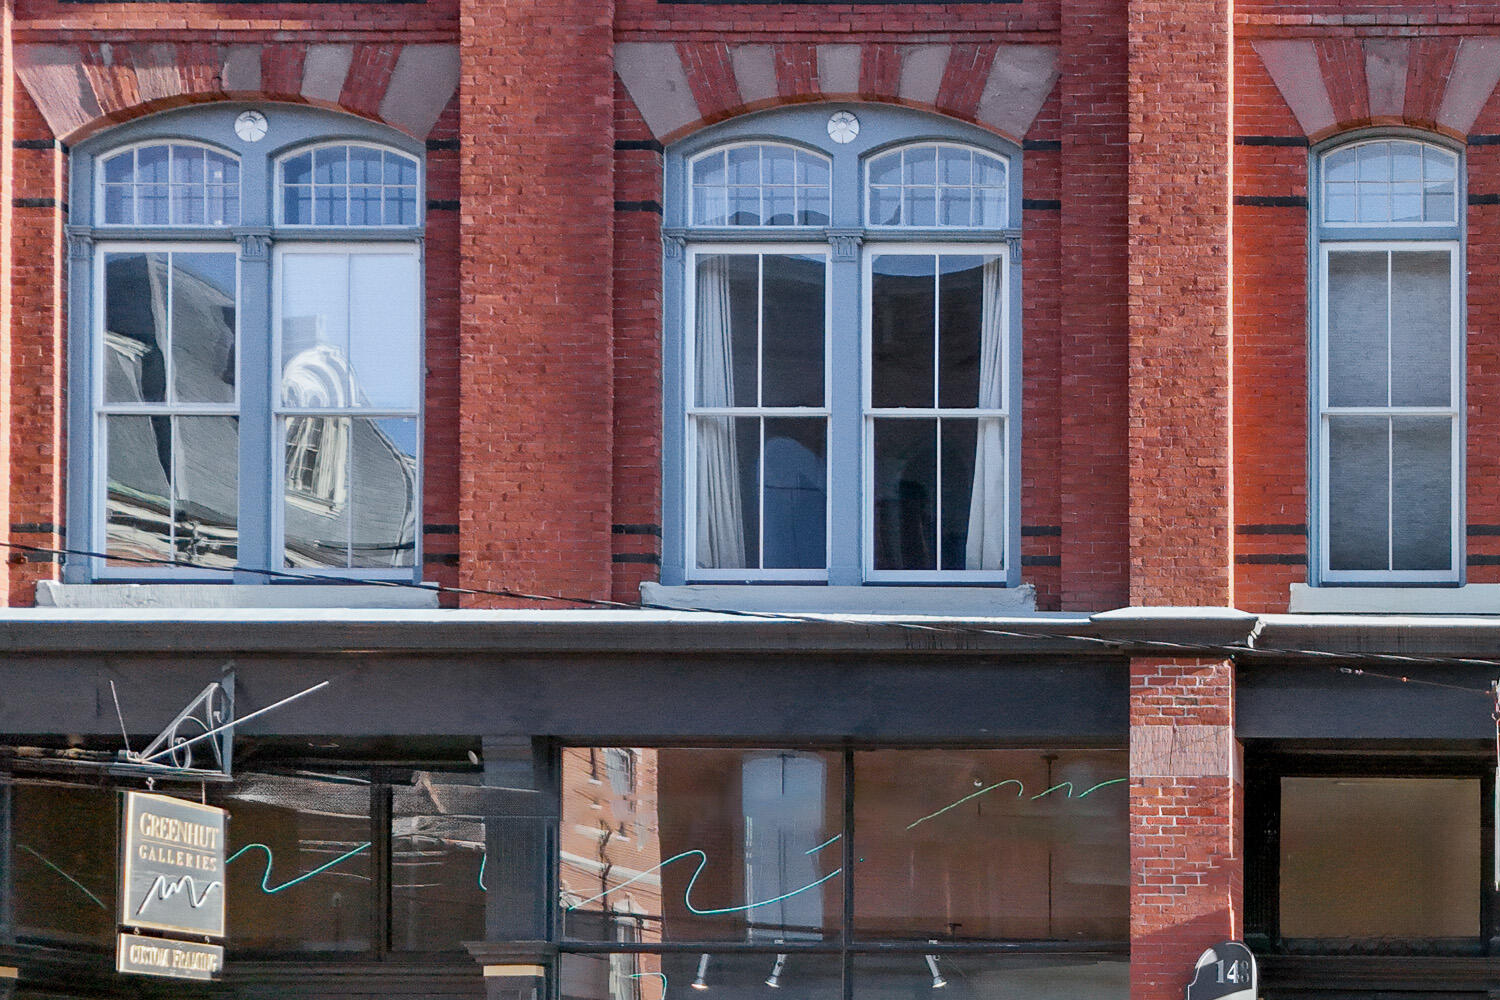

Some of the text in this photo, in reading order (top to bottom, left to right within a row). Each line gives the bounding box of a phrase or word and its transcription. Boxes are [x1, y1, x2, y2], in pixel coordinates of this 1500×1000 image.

[139, 812, 219, 850] GREENHUT
[138, 844, 217, 872] GALLERIES
[130, 944, 218, 973] CUSTOM FRAMING
[1214, 959, 1250, 984] 148
